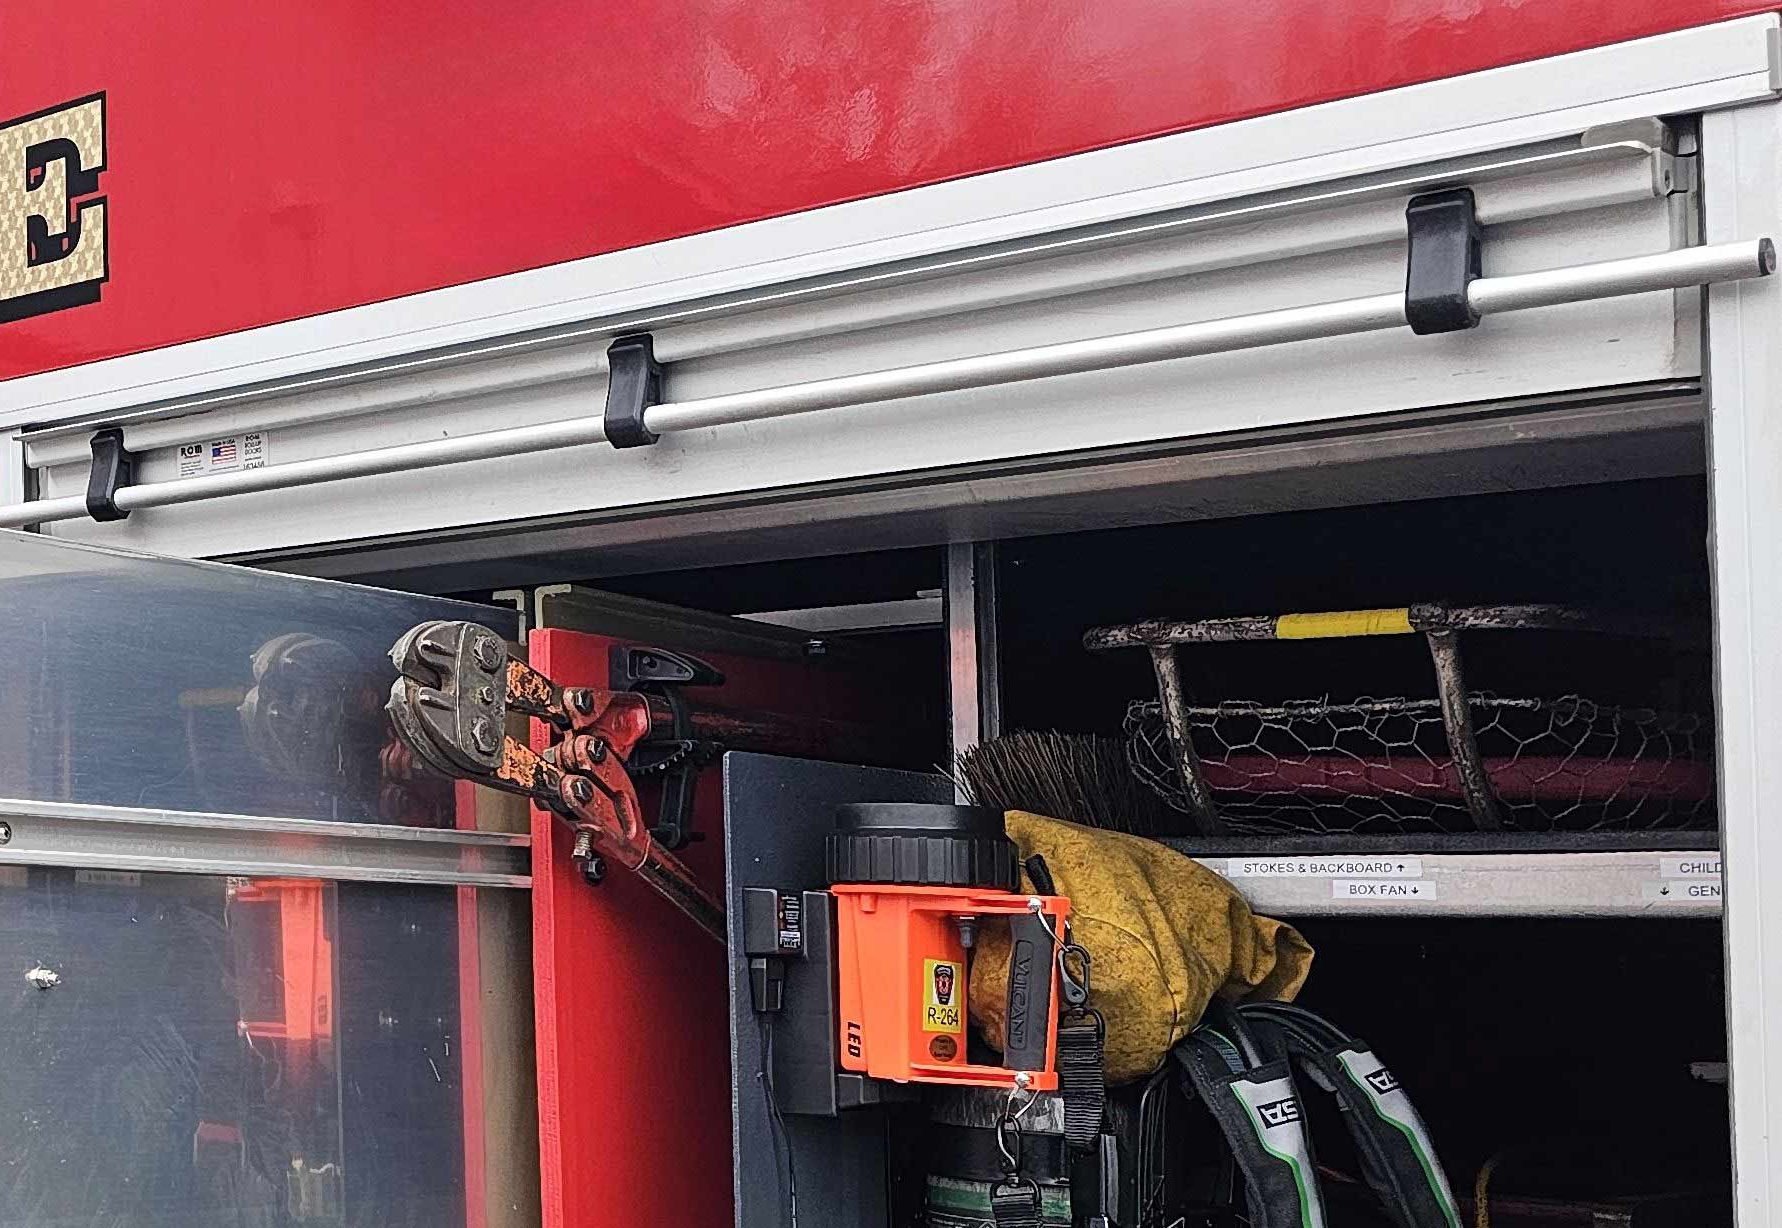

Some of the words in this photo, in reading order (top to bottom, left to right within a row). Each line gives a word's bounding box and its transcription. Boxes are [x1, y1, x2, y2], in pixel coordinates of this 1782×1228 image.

[1243, 863, 1294, 873] STOKES
[1298, 863, 1306, 873] &
[1310, 863, 1392, 873] BACKBOARD
[1349, 885, 1376, 895] BOX
[1380, 885, 1407, 895] FAN
[927, 1007, 959, 1026] R-264
[847, 1021, 862, 1058] LED
[1260, 1100, 1299, 1125] SA
